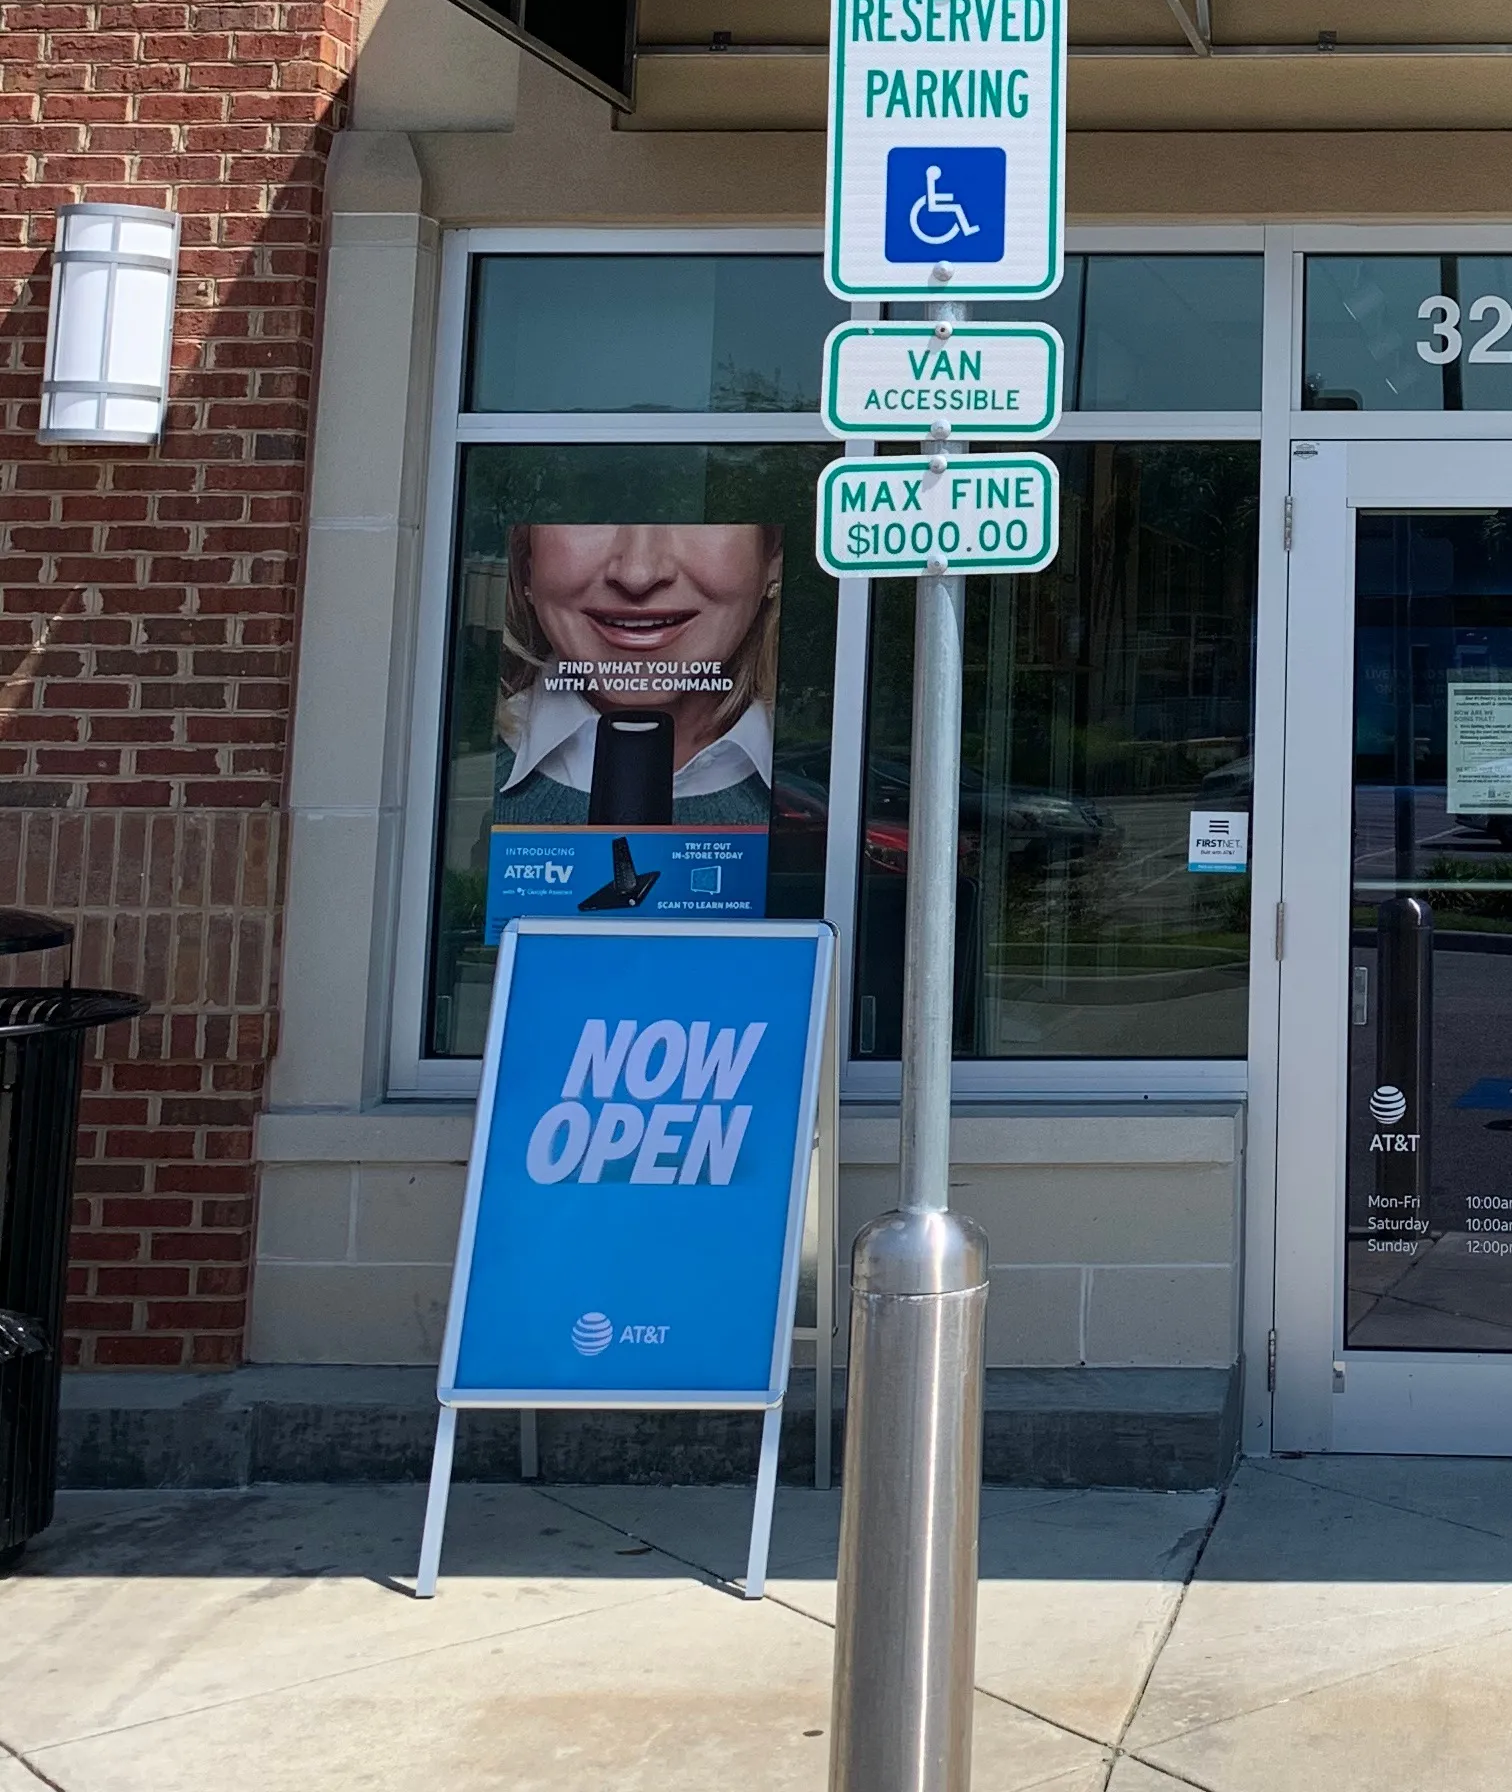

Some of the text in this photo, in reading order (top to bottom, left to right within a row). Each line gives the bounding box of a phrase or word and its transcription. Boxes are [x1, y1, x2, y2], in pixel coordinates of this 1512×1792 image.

[866, 69, 1029, 119] PARKING
[908, 350, 982, 381] VAN
[865, 388, 1020, 411] ACCESSIBLE
[841, 477, 1034, 512] MAX FINE
[847, 518, 1027, 556] $1000.00
[558, 662, 722, 674] FIND WHAT YOU LOVE
[544, 678, 734, 691] WITH A VOICE COMMAND
[506, 847, 575, 856] INTRODUCING
[685, 842, 732, 851] TRY IT OUT
[672, 851, 744, 860] IN-STORE TODAY
[657, 901, 680, 910] SCAN
[682, 901, 694, 910] TO
[696, 901, 723, 910] LEARN
[561, 1019, 768, 1100] NOW
[526, 1100, 752, 1185] OPEN
[1369, 1134, 1420, 1152] AT&T
[1368, 1196, 1420, 1208] Mon-Fri
[1368, 1217, 1429, 1233] Saturday
[1368, 1239, 1418, 1255] Sunday
[619, 1325, 670, 1344] AT&T
